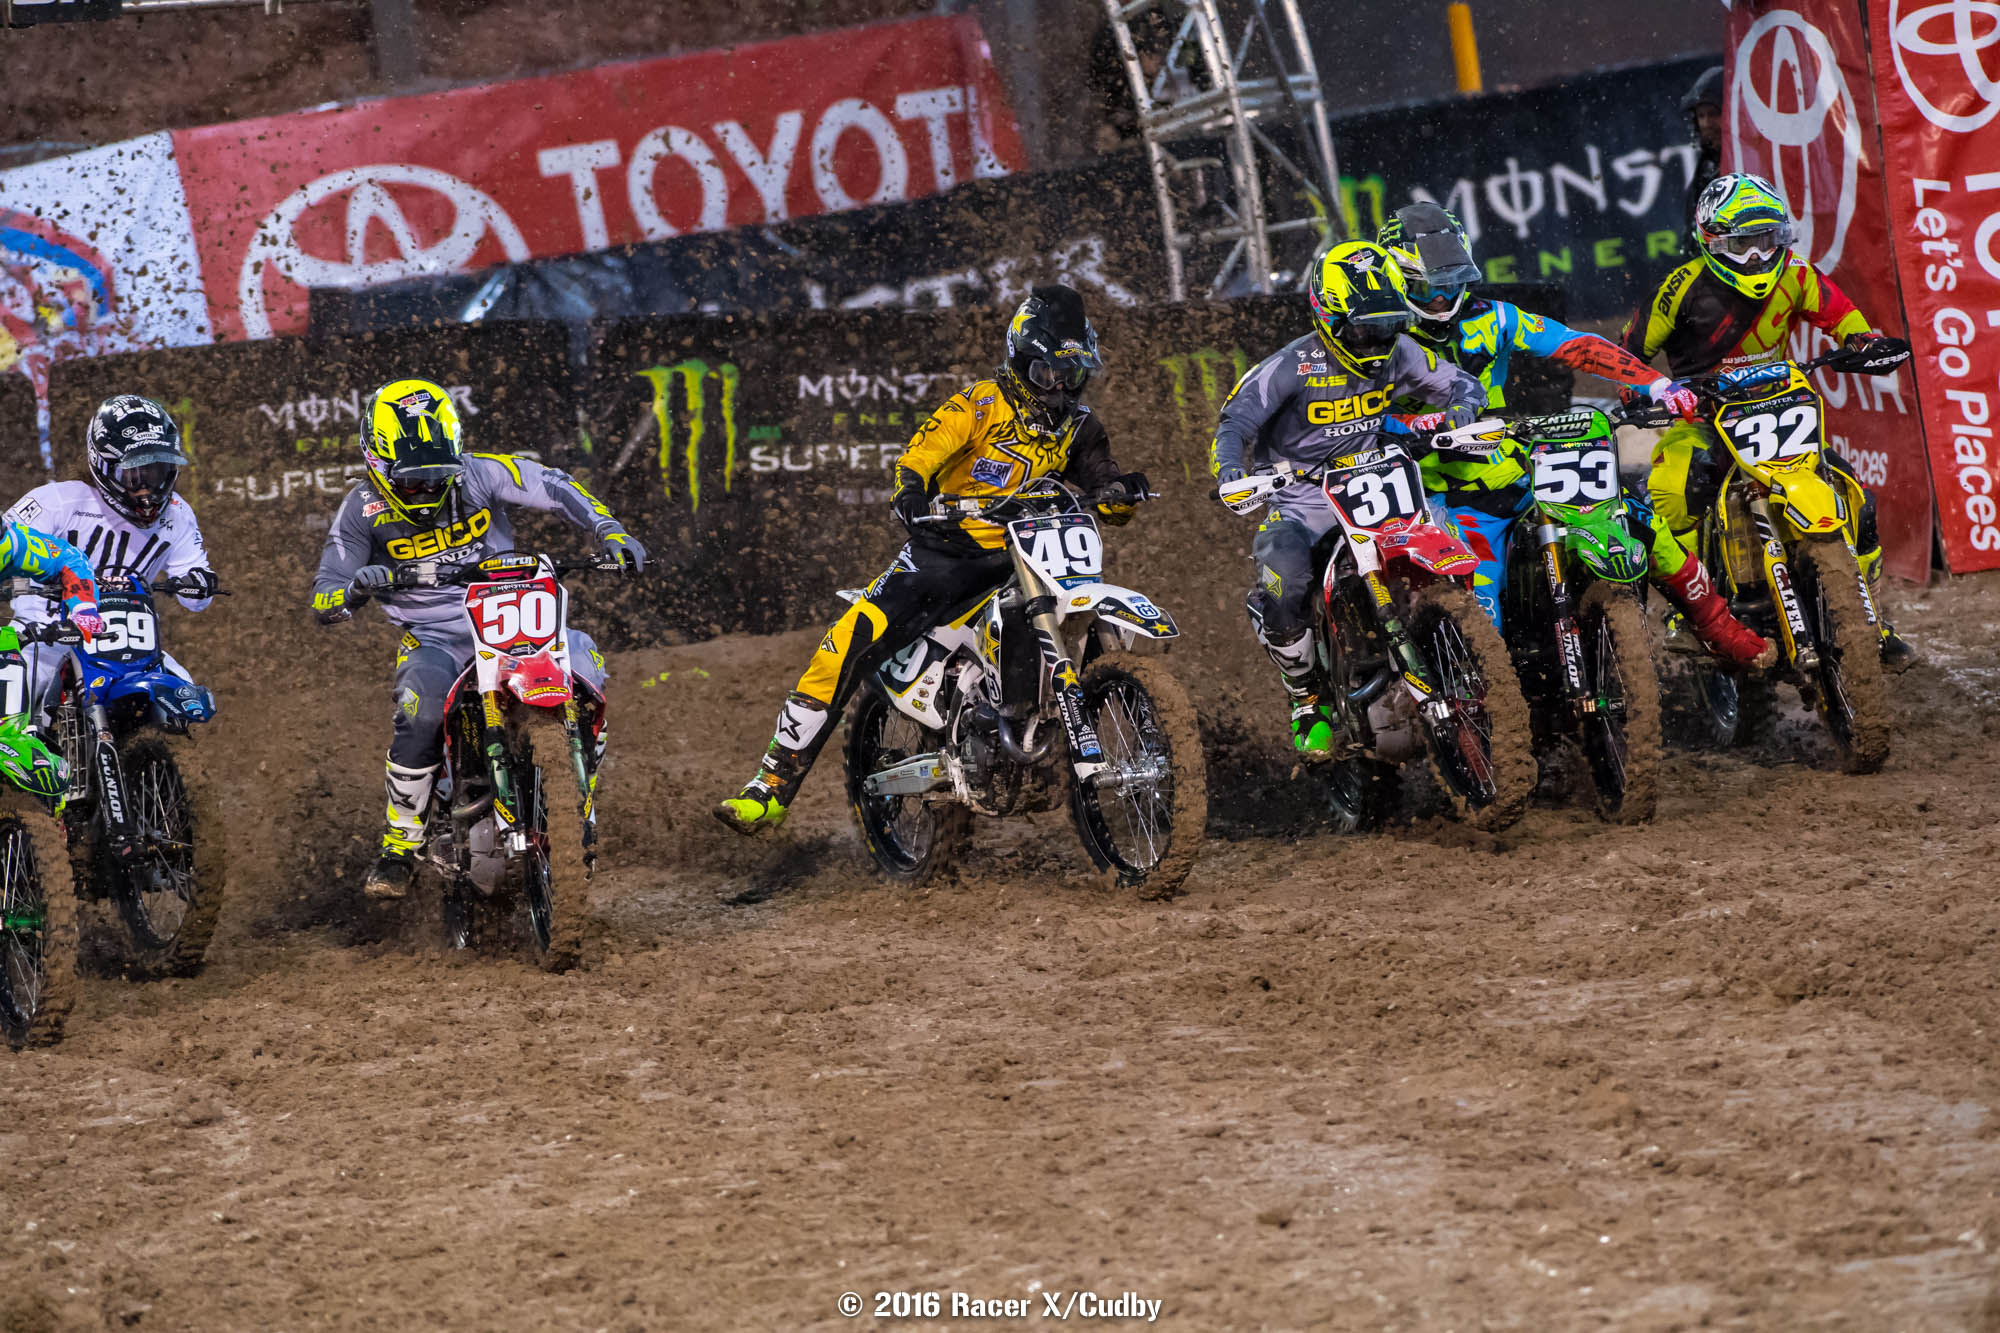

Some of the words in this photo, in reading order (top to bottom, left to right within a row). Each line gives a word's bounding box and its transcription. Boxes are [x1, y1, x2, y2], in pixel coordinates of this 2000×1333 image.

[1411, 145, 1697, 241] MONST
[1486, 229, 1681, 284] ENER
[1913, 177, 1964, 293] Let's
[1933, 307, 1975, 378] Go
[1323, 414, 1382, 438] HOND
[1752, 396, 1793, 410] MONSTER
[1734, 406, 1818, 466] 32
[1358, 463, 1390, 473] MONSTER
[1534, 450, 1617, 504] 53
[1946, 388, 2000, 551] Places
[1347, 467, 1415, 527] 31
[386, 507, 492, 560] GEICO
[432, 541, 485, 563] ONDA
[1030, 526, 1102, 578] 49
[497, 583, 532, 591] MONSTER
[1433, 554, 1475, 569] GEICO
[1441, 560, 1475, 571] HONDA
[482, 590, 557, 645] 50
[523, 686, 569, 698] GEICO
[1404, 671, 1431, 694] GEICO
[1056, 691, 1079, 750] DUNLOP
